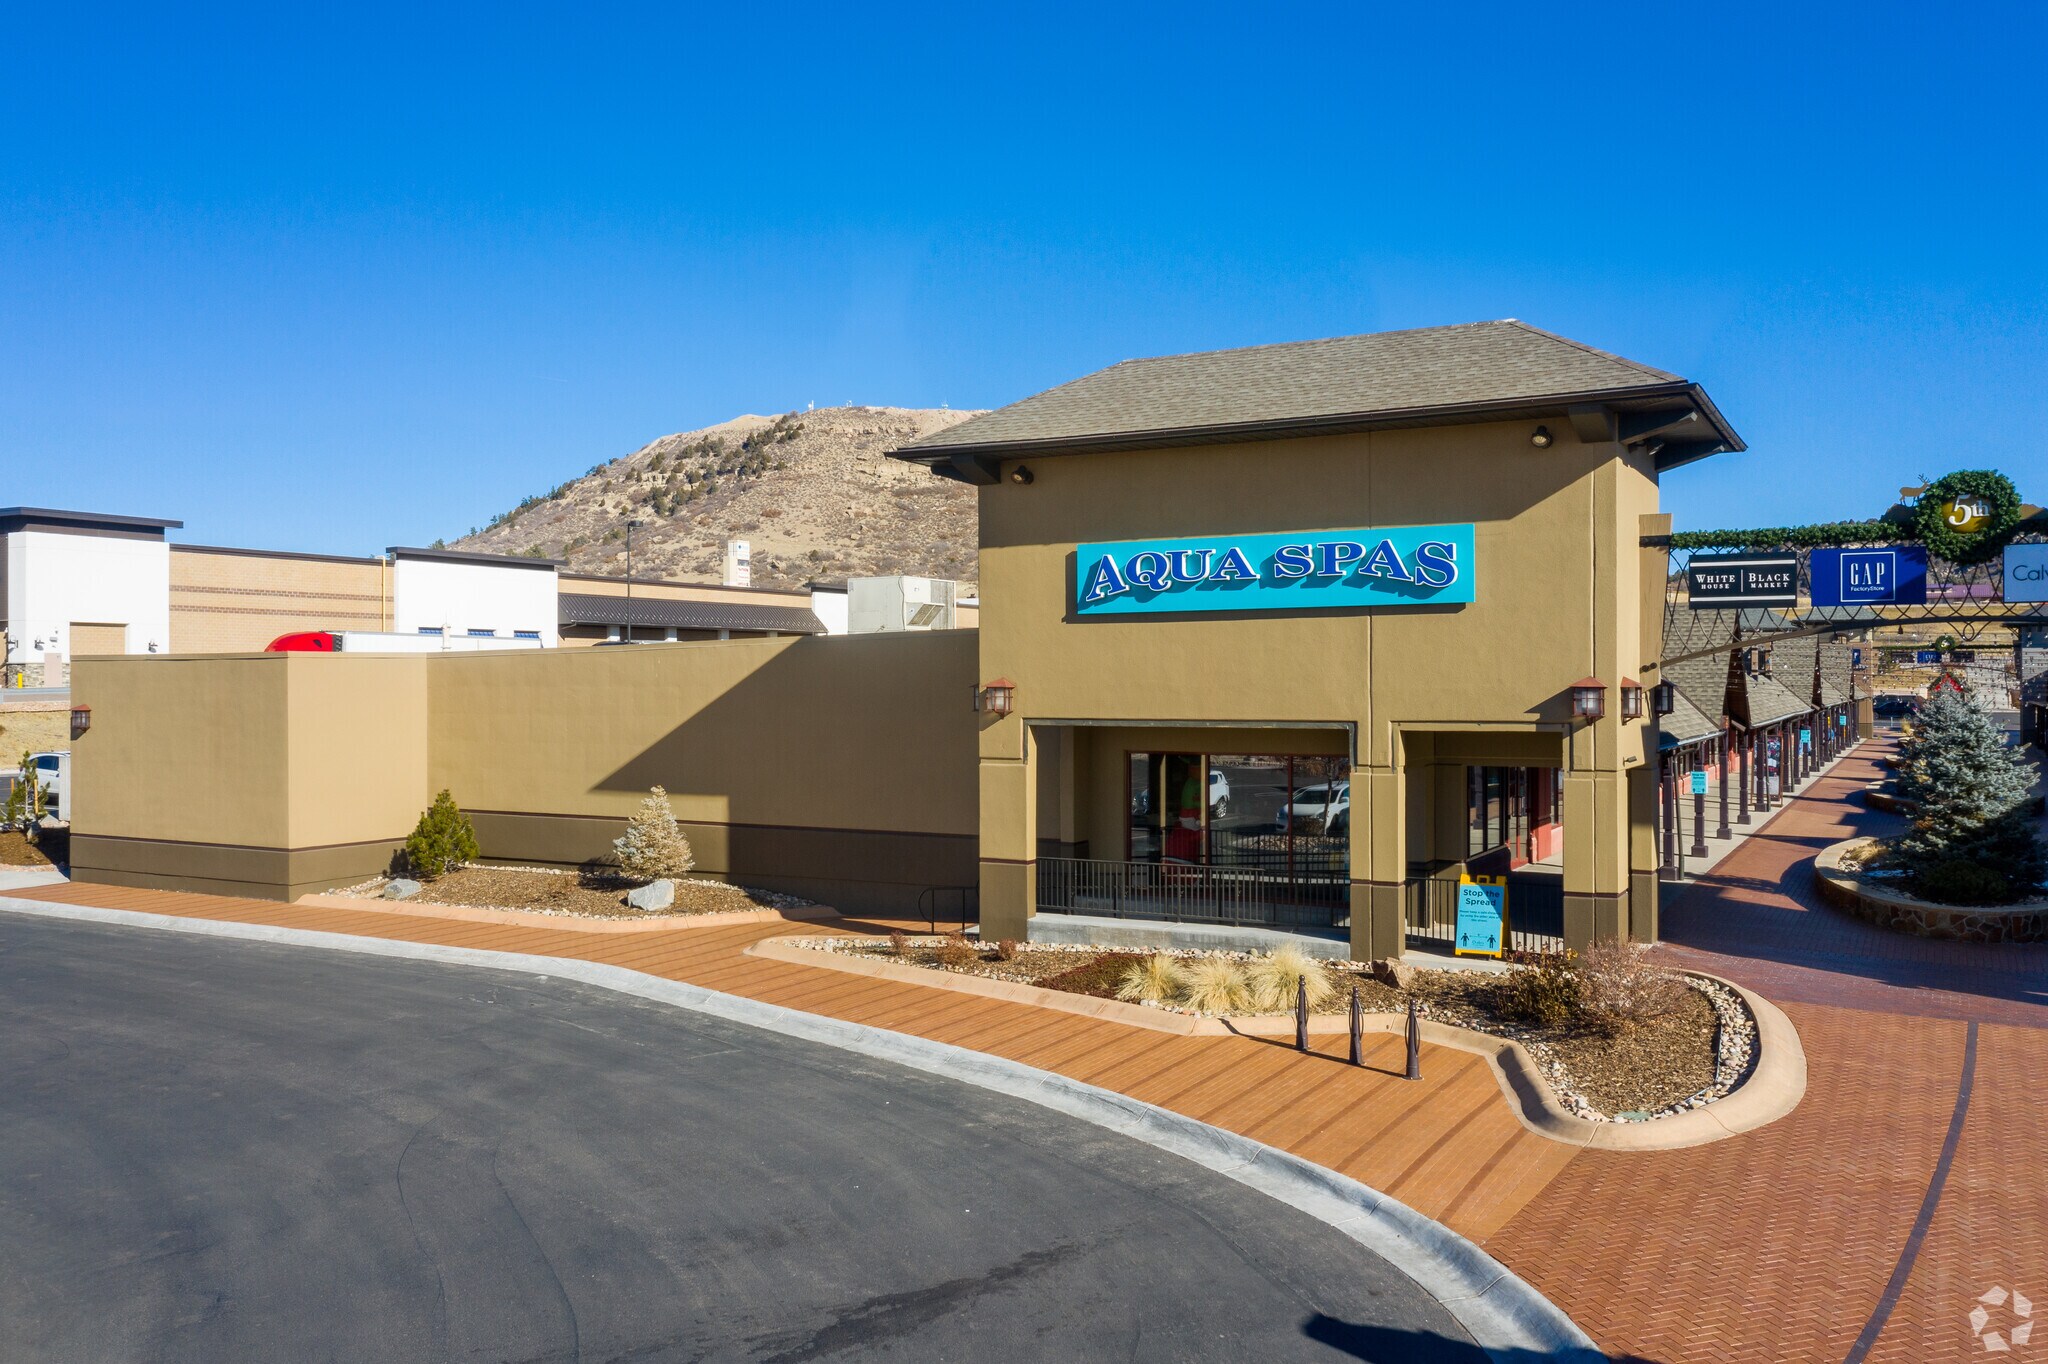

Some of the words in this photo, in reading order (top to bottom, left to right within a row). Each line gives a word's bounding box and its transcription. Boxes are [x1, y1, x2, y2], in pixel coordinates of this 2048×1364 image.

[1948, 493, 1990, 526] 5th
[1085, 546, 1261, 602] AQUA
[1273, 538, 1460, 588] SPAS
[1850, 562, 1885, 585] GAP
[1695, 574, 1736, 583] WHITE
[1748, 573, 1790, 582] BLACK
[1463, 889, 1483, 897] Stop
[1485, 890, 1500, 898] the
[1465, 898, 1496, 906] Spread
